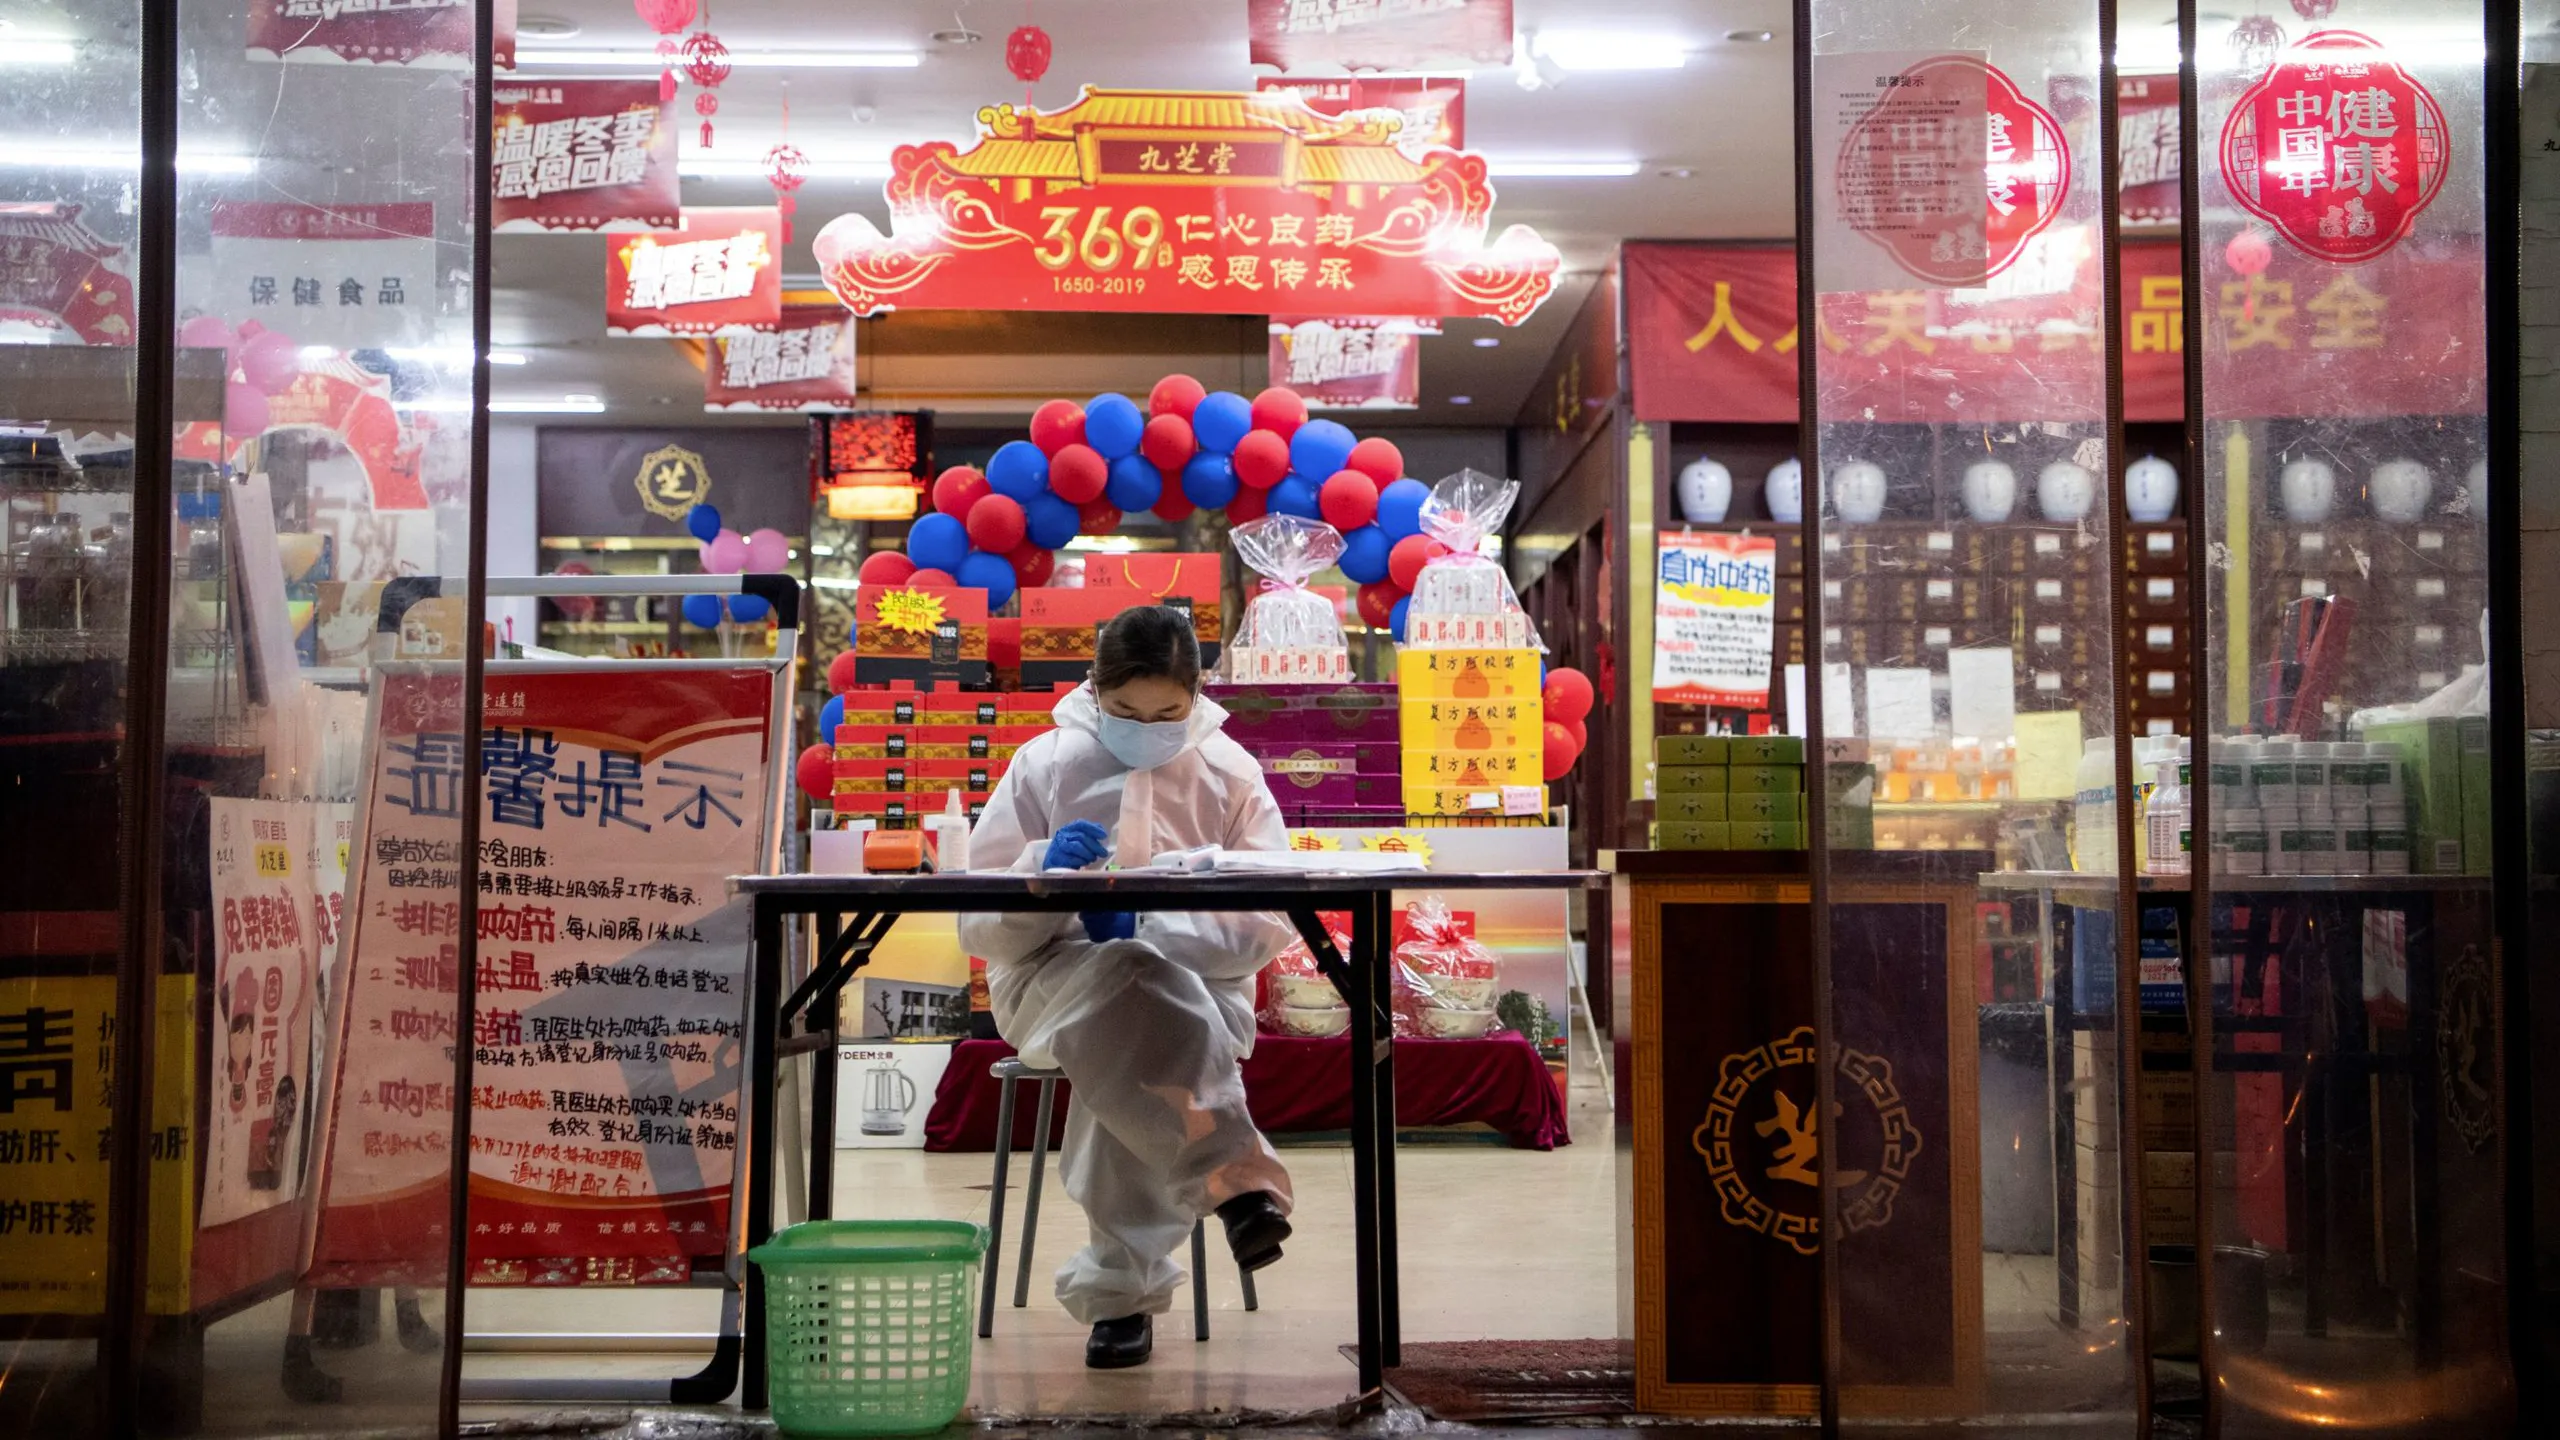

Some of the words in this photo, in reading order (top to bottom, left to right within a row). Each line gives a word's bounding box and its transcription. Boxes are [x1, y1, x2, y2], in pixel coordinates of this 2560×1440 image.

[1875, 76, 1925, 88] 温馨提示
[493, 108, 655, 166] 温暖冬季
[2325, 86, 2400, 195] 健康
[1139, 142, 1236, 174] 九芝堂
[1034, 206, 1164, 272] 369
[1175, 213, 1355, 248] 仁心良药
[1053, 277, 1146, 294] 1650-2019
[1176, 254, 1356, 291] 感恩传承
[250, 276, 404, 306] 保健食品
[385, 726, 744, 833] 温馨提示
[597, 1221, 707, 1235] 信赖九芝堂
